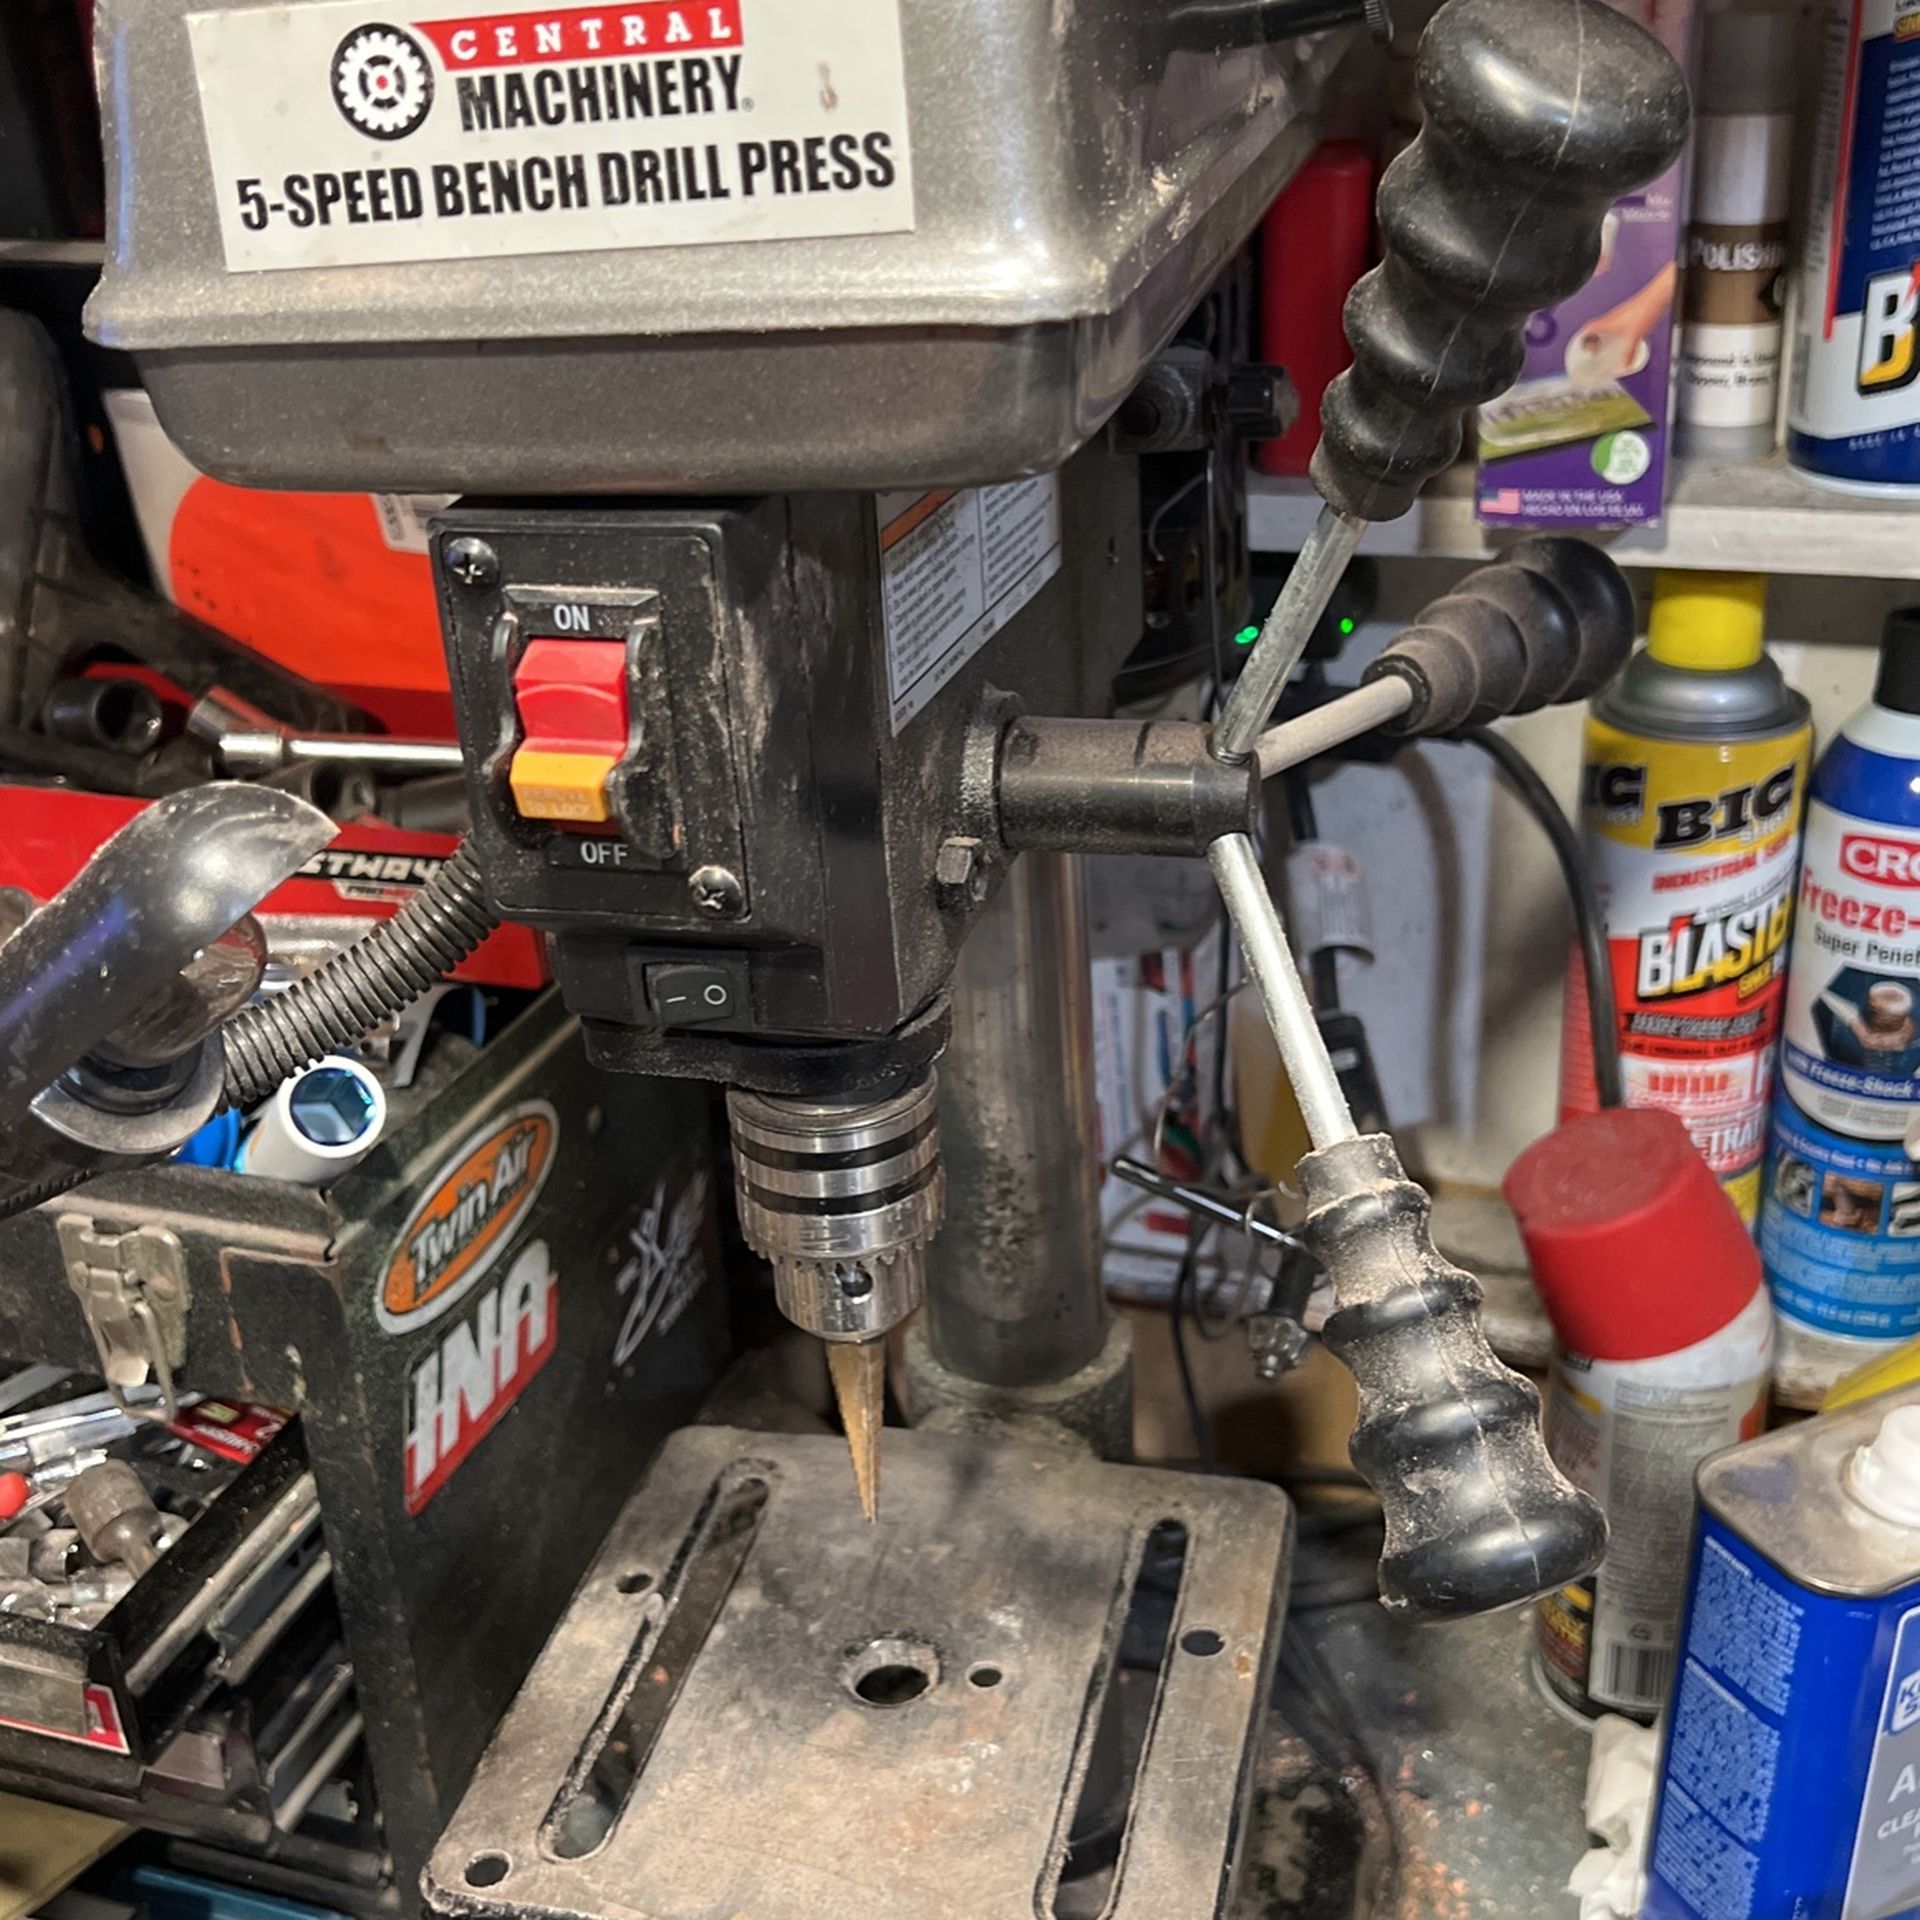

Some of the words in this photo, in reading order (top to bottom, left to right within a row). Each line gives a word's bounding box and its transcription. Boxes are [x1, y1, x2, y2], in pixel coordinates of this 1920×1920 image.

[450, 6, 733, 61] CENTRAL
[456, 54, 743, 132] MACHINERY
[237, 165, 422, 231] 5-SPEED
[431, 155, 588, 219] BENCH
[599, 144, 729, 206] DRILL
[738, 132, 896, 197] PRESS
[553, 604, 591, 632] ON
[580, 841, 628, 866] OFF
[1814, 922, 1859, 956] Super
[411, 1180, 490, 1284] Twin
[490, 1131, 537, 1205] Air
